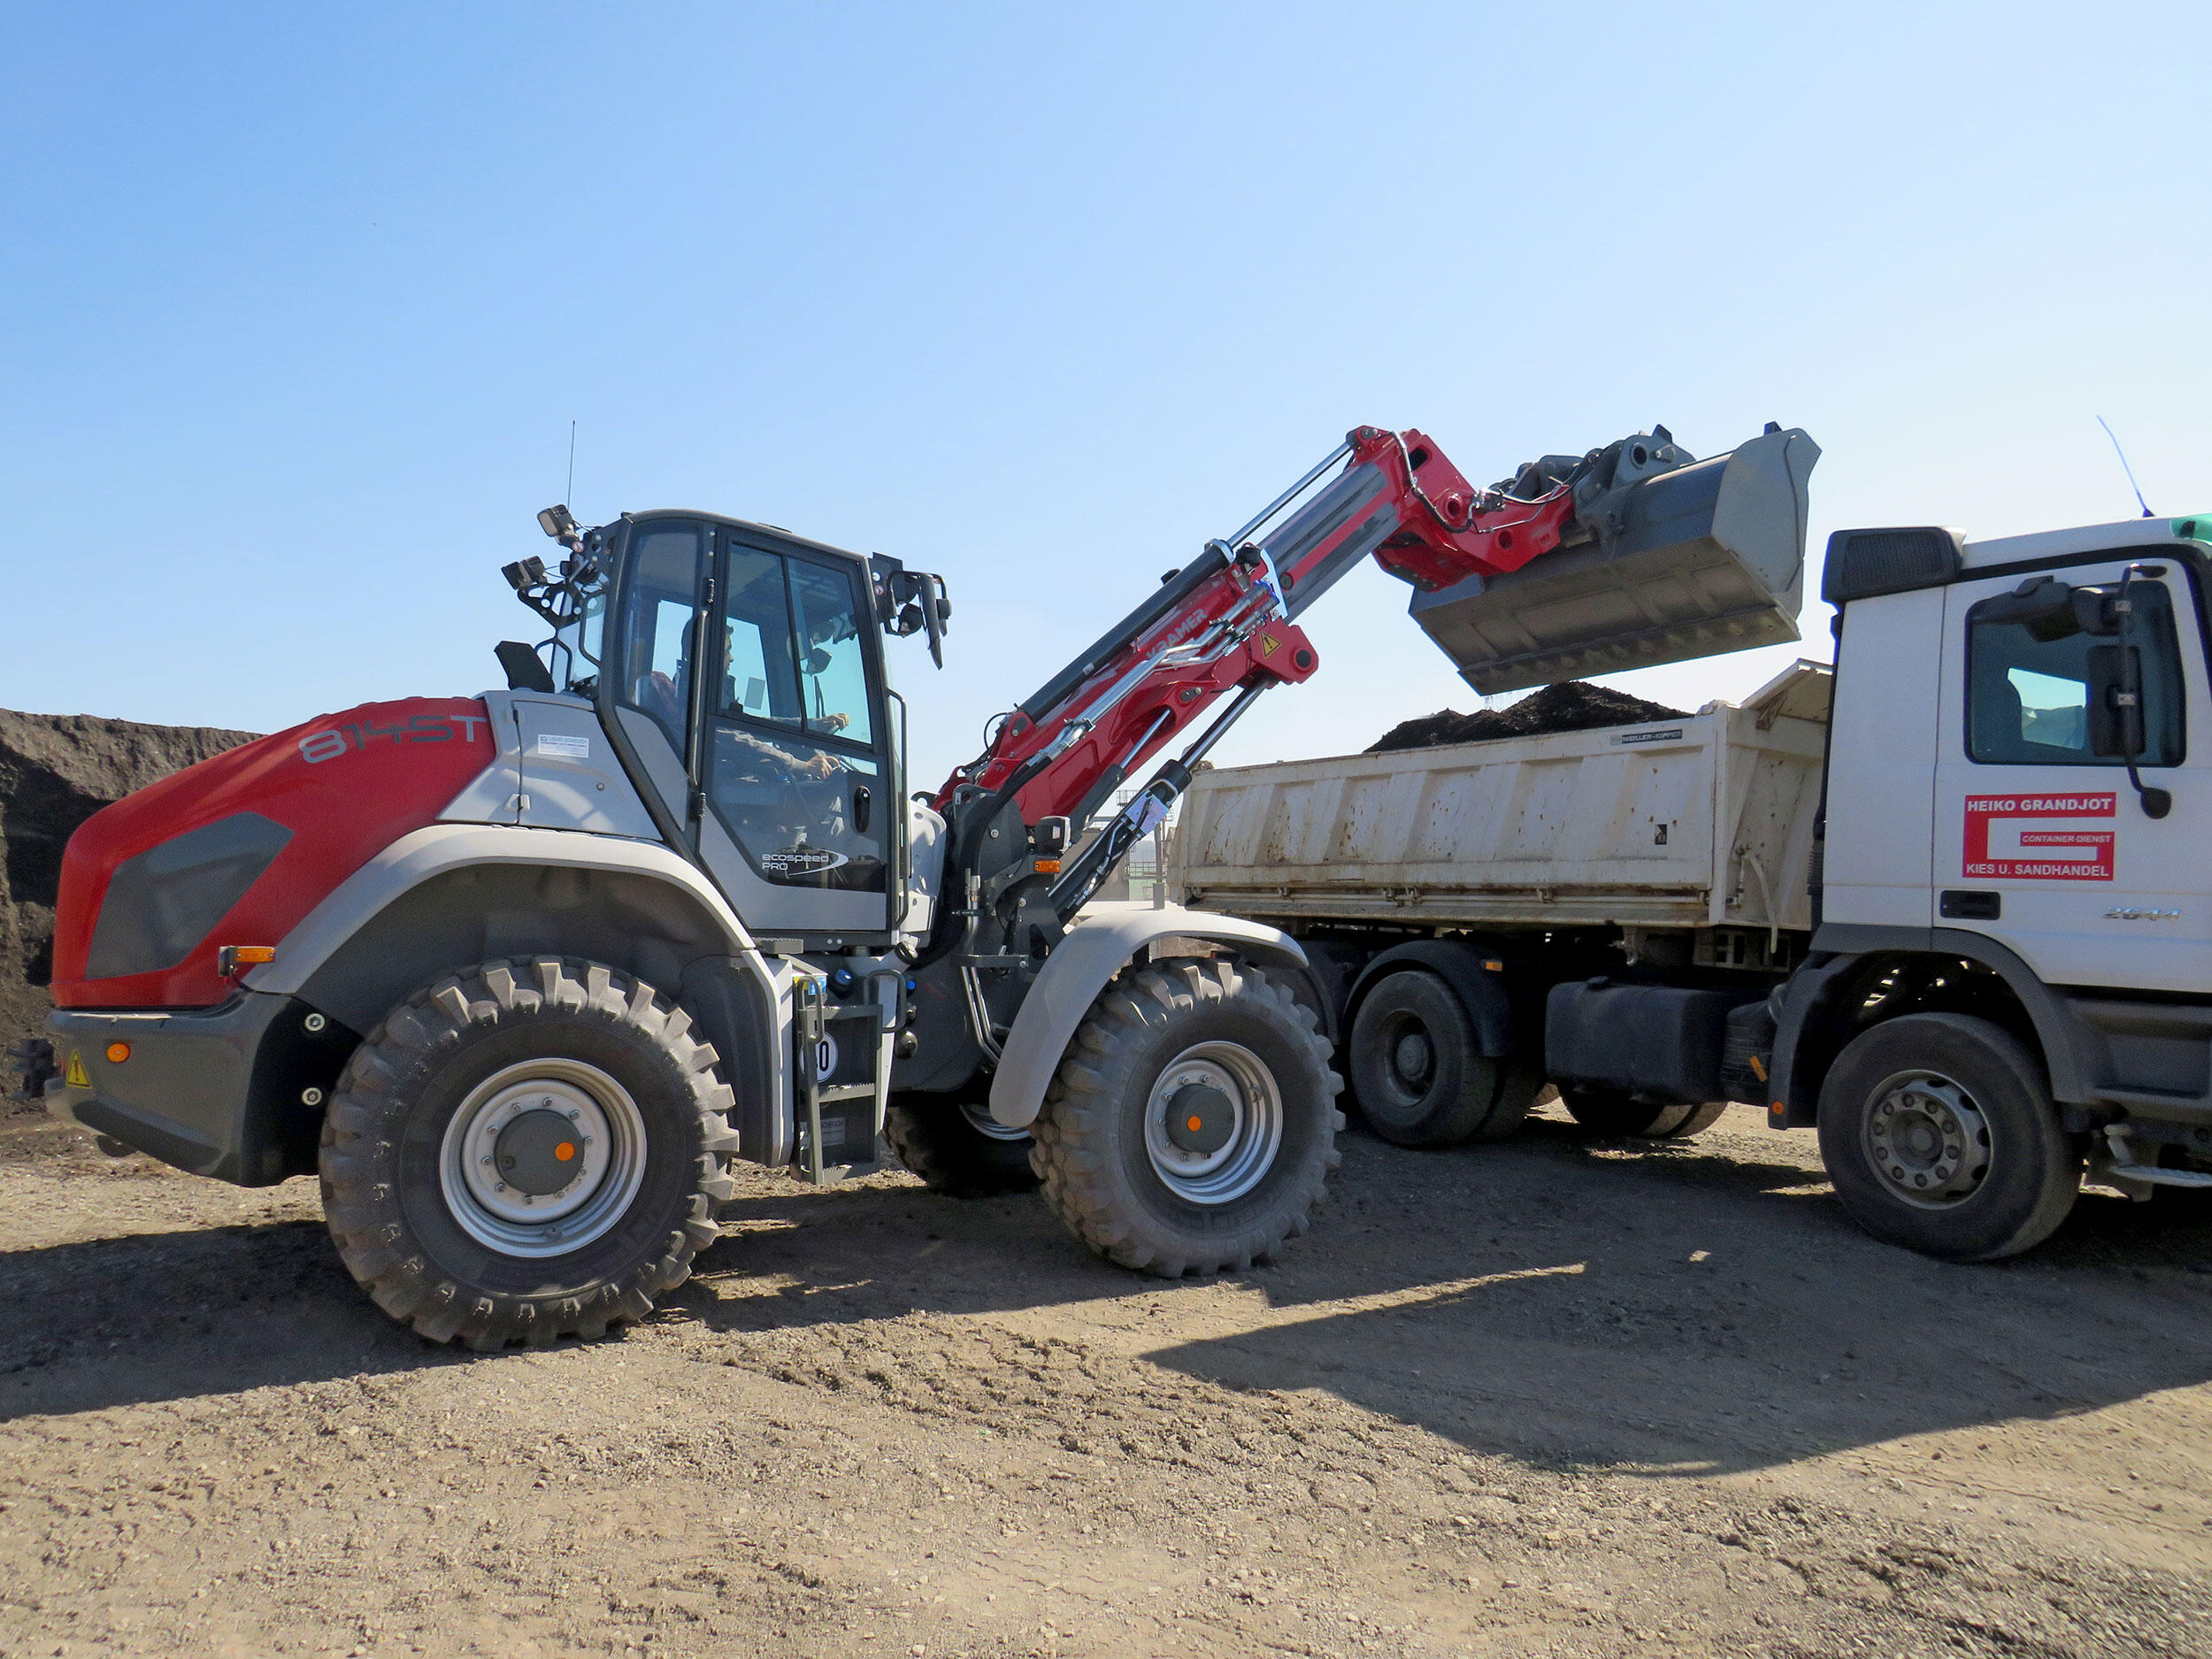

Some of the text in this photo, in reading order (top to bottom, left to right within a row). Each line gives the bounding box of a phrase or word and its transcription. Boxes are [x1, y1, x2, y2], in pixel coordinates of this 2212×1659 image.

[298, 715, 488, 764] 8145T
[1967, 798, 2112, 812] HEIKO GRANDJOT
[2022, 834, 2111, 843] CONTAINER-DIENST
[762, 854, 829, 864] ecospeed
[762, 862, 788, 871] PRO
[1966, 864, 2109, 877] KIES U. SANDHANDEL
[815, 1041, 829, 1071] 0
